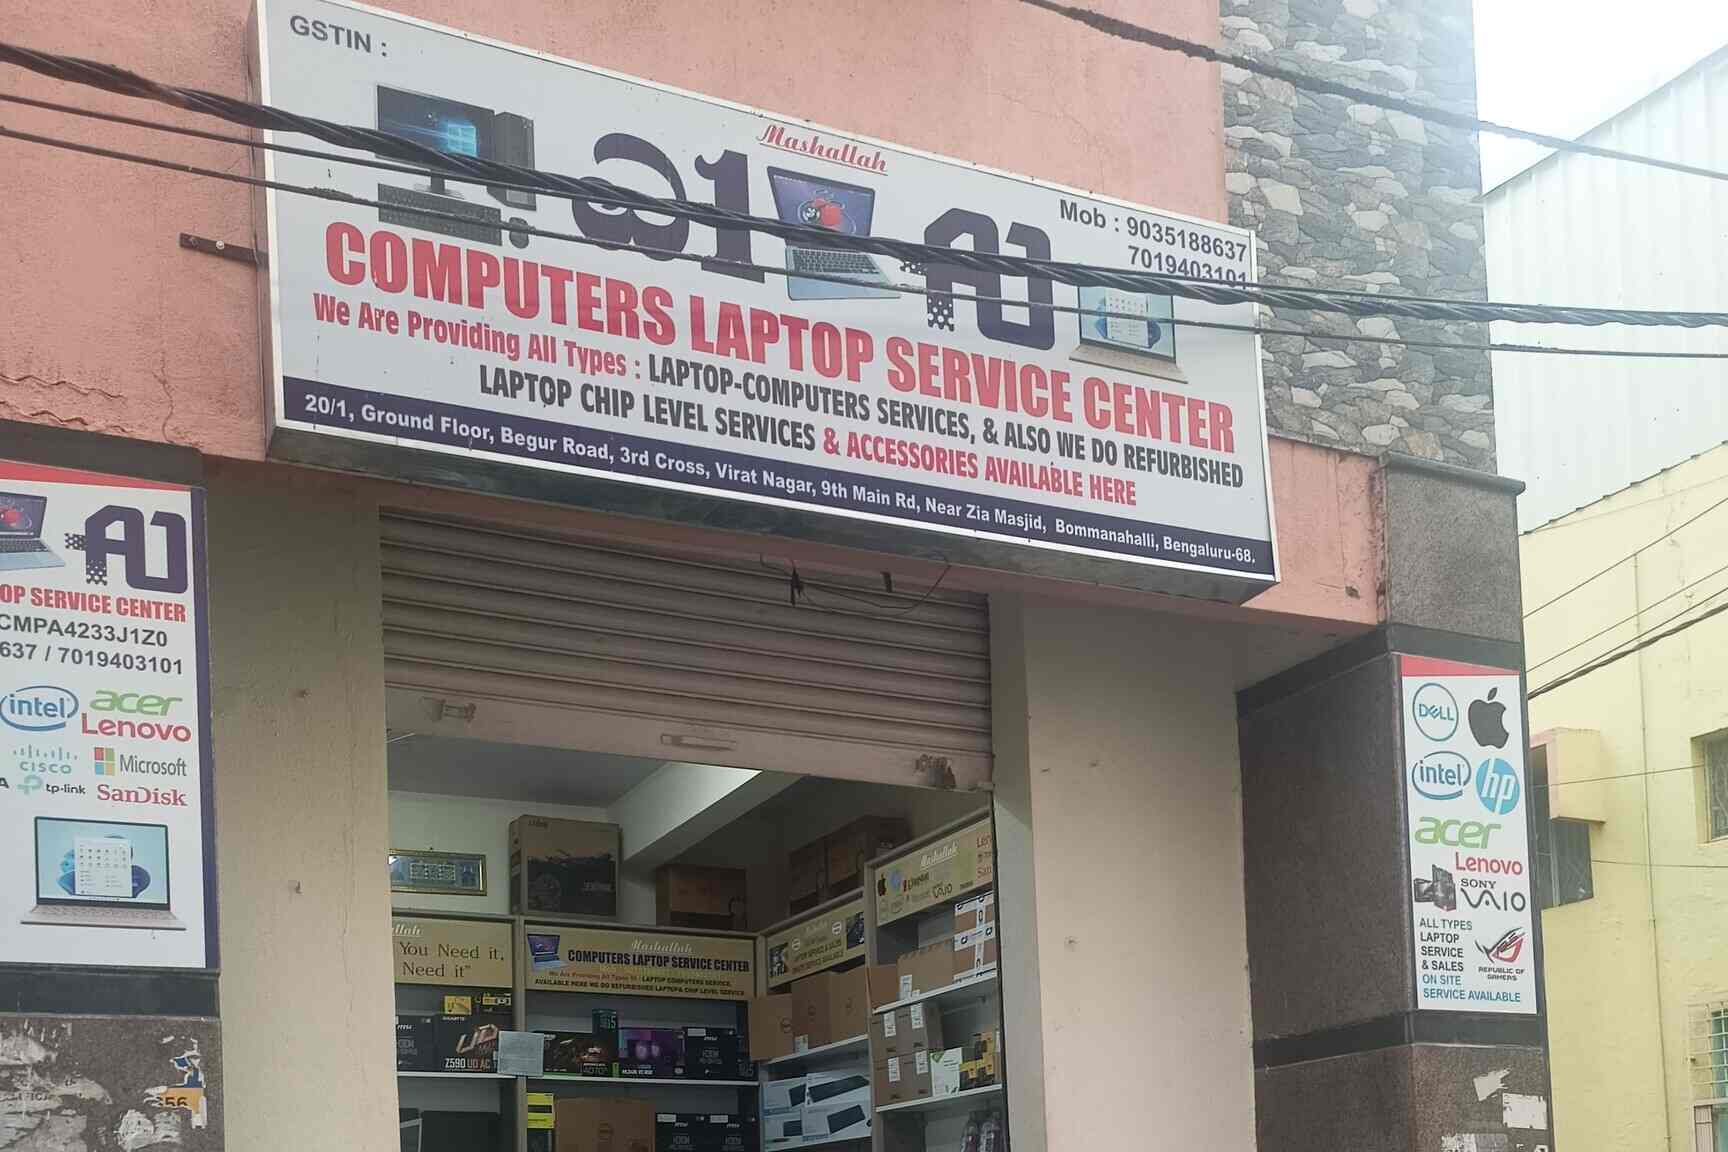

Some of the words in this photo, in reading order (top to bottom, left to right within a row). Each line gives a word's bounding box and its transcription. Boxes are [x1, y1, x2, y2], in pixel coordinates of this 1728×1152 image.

[289, 15, 372, 53] GSTIN
[756, 124, 888, 173] Mashallah
[1059, 199, 1107, 229] Mob
[1126, 216, 1248, 262] 9035188637
[325, 222, 676, 346] COMPUTERS
[689, 295, 874, 383] LAPTOP
[886, 336, 1073, 423] SERVICE
[1083, 376, 1235, 454] CENTER
[313, 293, 350, 326] We
[358, 302, 399, 334] Are
[407, 310, 520, 361] Providing
[528, 334, 557, 364] All
[564, 340, 627, 376] Types
[648, 353, 870, 421] LAPTOP-COMPUTERS
[877, 397, 975, 444] SERVICES,
[983, 417, 998, 445] &
[1004, 421, 1051, 455] ALSO
[1056, 431, 1086, 461] WE
[1092, 438, 1118, 466] DO
[1124, 443, 1244, 489] REFURBISHED
[480, 364, 572, 408] LAPTOP
[580, 383, 635, 419] CHIP
[643, 394, 708, 433] LEVEL
[715, 407, 816, 451] SERVICES
[823, 427, 841, 456] &
[847, 431, 978, 479] ACCESSORIES
[984, 456, 1084, 497] AVAILABLE
[1089, 475, 1137, 506] HERE
[304, 394, 355, 422] 20/1,
[361, 404, 434, 431] Ground
[441, 416, 495, 445] Floor,
[501, 426, 557, 452] Begur
[562, 437, 615, 463] Road,
[620, 446, 650, 467] 3rd
[655, 453, 711, 480] Cross,
[714, 462, 758, 484] Virat
[762, 471, 817, 497] Nagar,
[821, 479, 848, 499] 9th
[852, 485, 890, 506] Main
[895, 492, 921, 513] Rd,
[925, 497, 962, 517] Near
[966, 503, 990, 523] Zia
[994, 508, 1048, 535] Masjid,
[1055, 518, 1160, 552] Bommanahalli,
[31, 587, 112, 614] SERVICE
[116, 597, 187, 623] CENTER
[58, 647, 183, 675] 7019403101
[9, 693, 70, 719] intel
[90, 689, 183, 716] acer
[1418, 703, 1455, 721] DELL
[81, 713, 192, 742] Lenovo
[120, 754, 187, 777] Microsoft
[1419, 760, 1464, 786] intel
[46, 783, 86, 795] tp-link
[97, 784, 188, 807] SanDisk
[1481, 758, 1516, 814] hp
[1414, 816, 1502, 849] acer
[1455, 852, 1523, 876] Lenovo
[1460, 878, 1497, 889] SONY
[1420, 918, 1439, 929] ALL
[1440, 919, 1473, 930] TYPES
[1420, 932, 1460, 944] LAPTOP
[399, 942, 428, 957] You
[438, 943, 480, 960] Need
[568, 950, 631, 965] COMPUTERS
[632, 953, 670, 968] LAPTOP
[671, 955, 713, 970] SERVICE
[714, 958, 750, 973] CENTER
[1420, 946, 1464, 958] SERVICE
[402, 961, 445, 977] Need
[1422, 960, 1429, 970] &
[1431, 960, 1464, 972] SALES
[1422, 974, 1438, 985] ON
[1440, 975, 1462, 985] SITE
[1423, 988, 1466, 1000] SERVICE
[1468, 991, 1521, 1003] AVAILABLE
